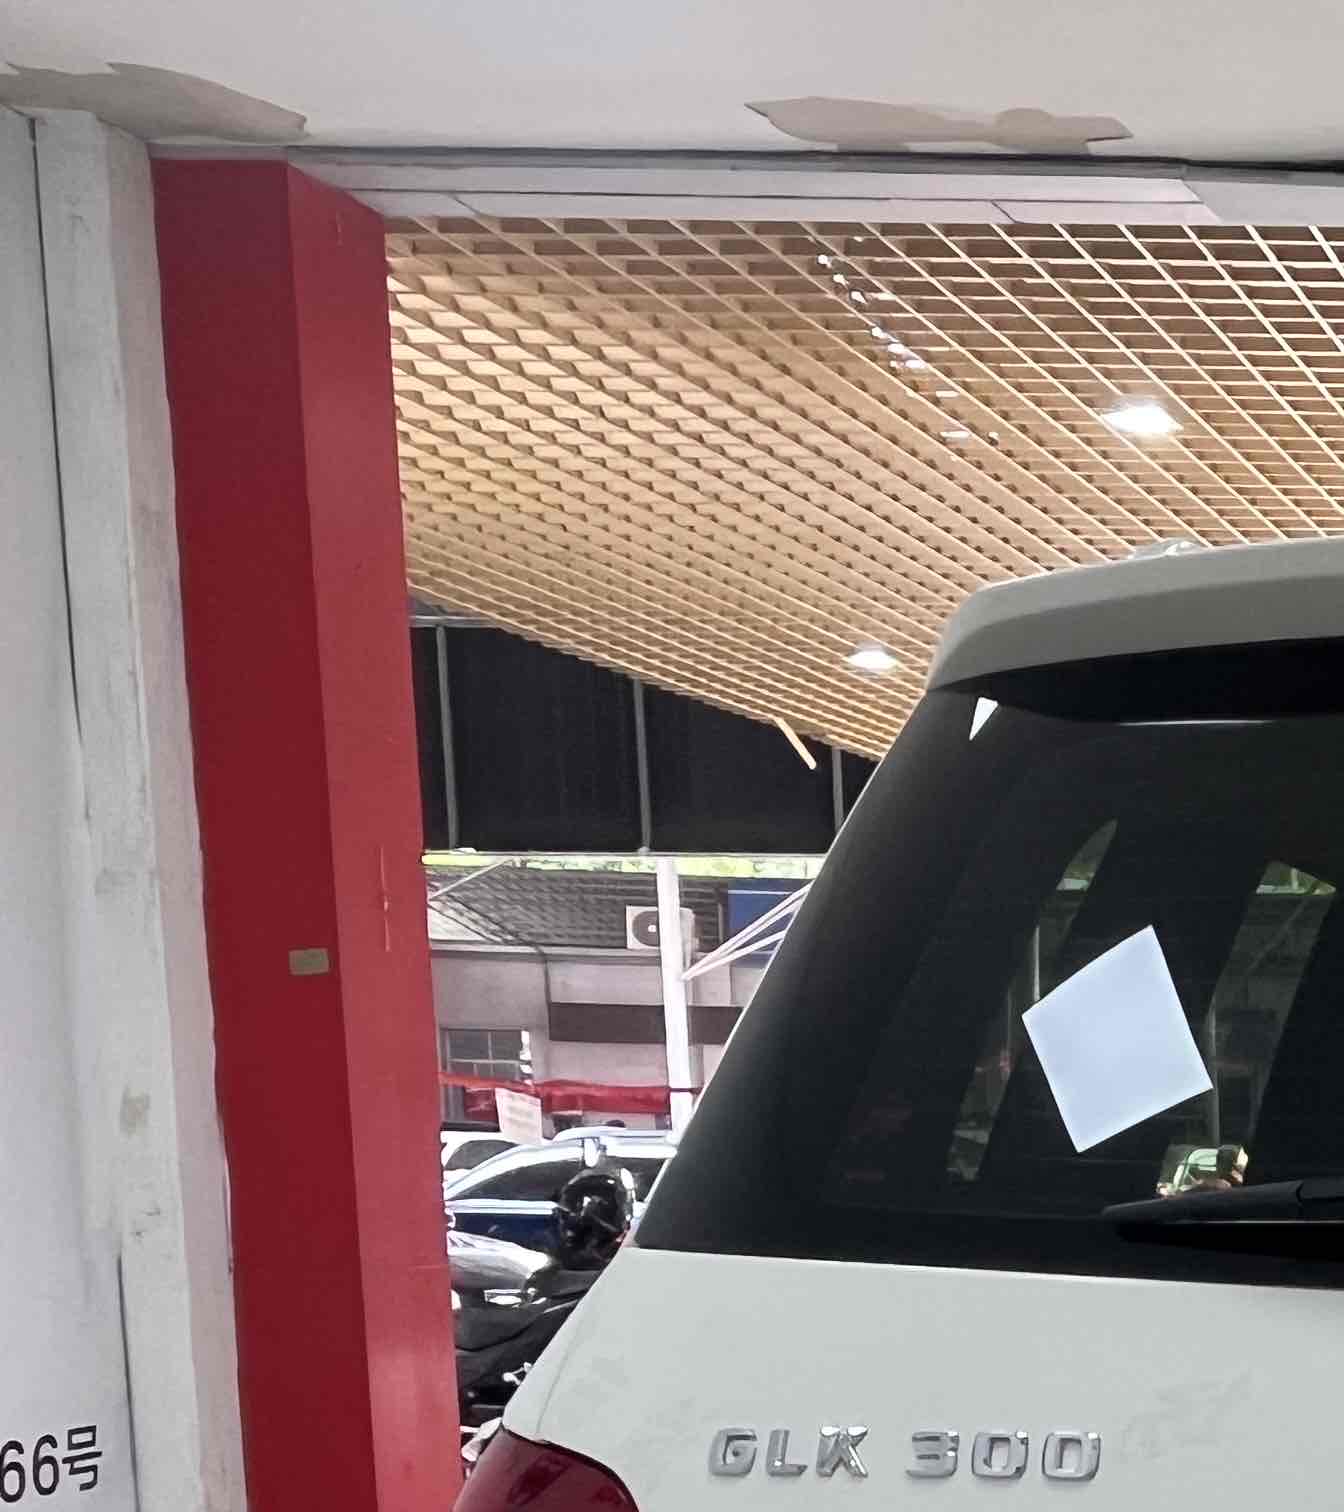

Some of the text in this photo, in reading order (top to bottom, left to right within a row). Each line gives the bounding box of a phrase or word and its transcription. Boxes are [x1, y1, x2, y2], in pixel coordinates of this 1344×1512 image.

[0, 1425, 102, 1503] 66号
[708, 1425, 1101, 1480] GLK 300
